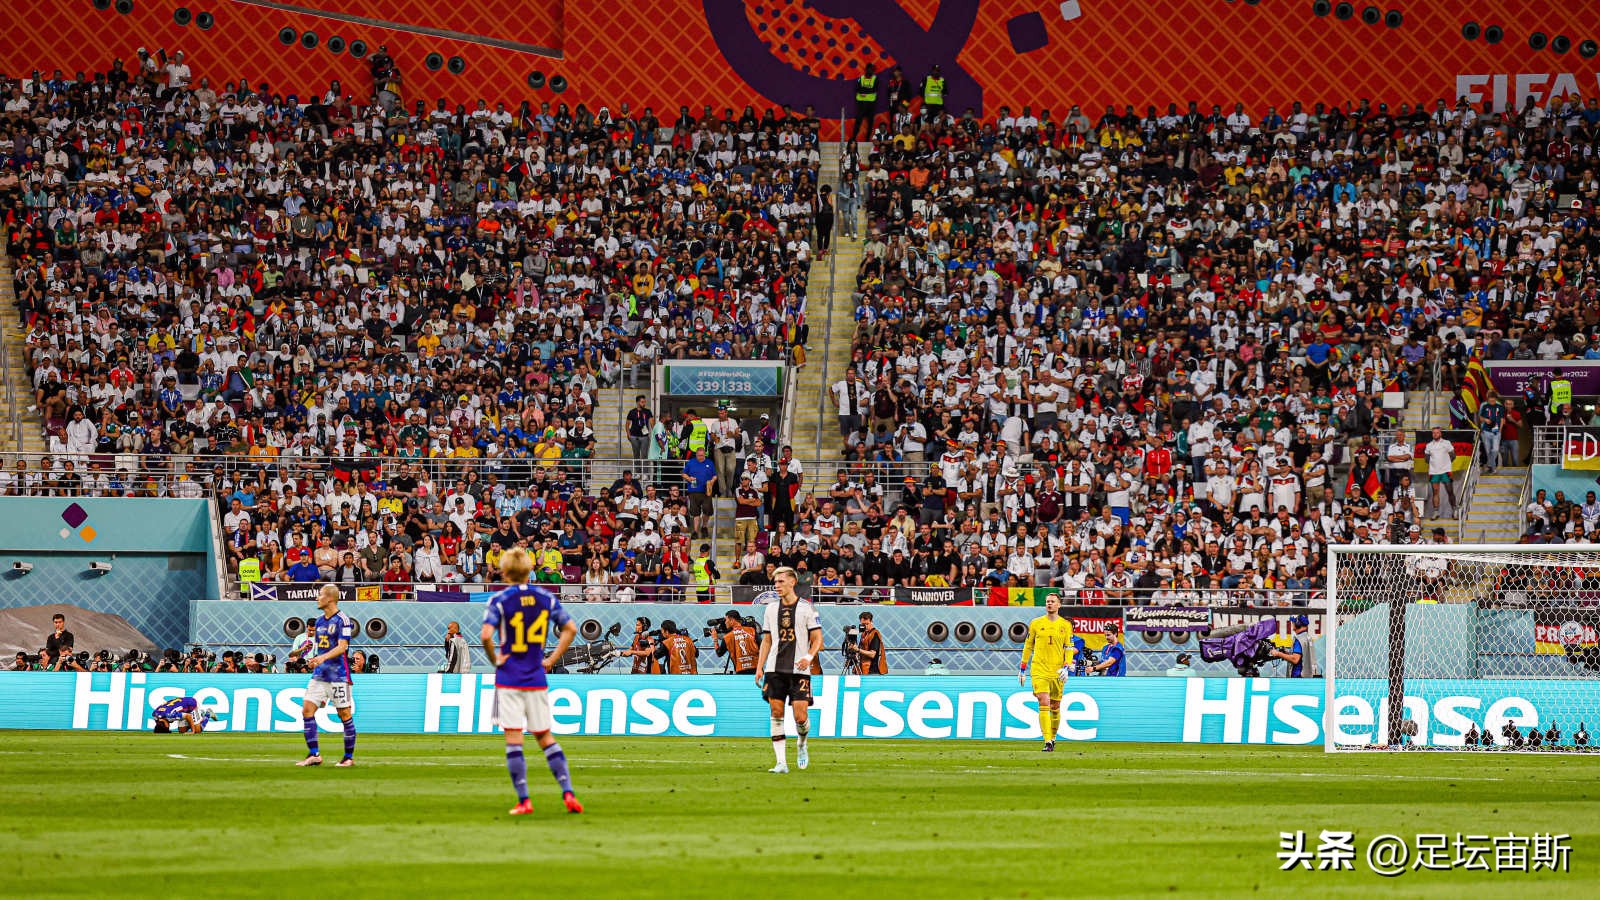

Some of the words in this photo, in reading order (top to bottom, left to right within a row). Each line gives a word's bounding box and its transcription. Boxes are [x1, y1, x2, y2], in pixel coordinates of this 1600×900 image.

[1456, 73, 1585, 113] FIFA
[696, 381, 719, 391] 339
[728, 381, 751, 391] 338
[1568, 432, 1597, 461] ED
[286, 589, 320, 600] TARTAN
[911, 591, 954, 602] HANNOVER
[509, 609, 549, 652] 14
[780, 629, 795, 642] 23
[318, 635, 330, 649] 25
[1047, 635, 1053, 645] 1
[332, 687, 345, 699] 25
[423, 673, 717, 736] Hiense
[1182, 677, 1539, 746] Hisense
